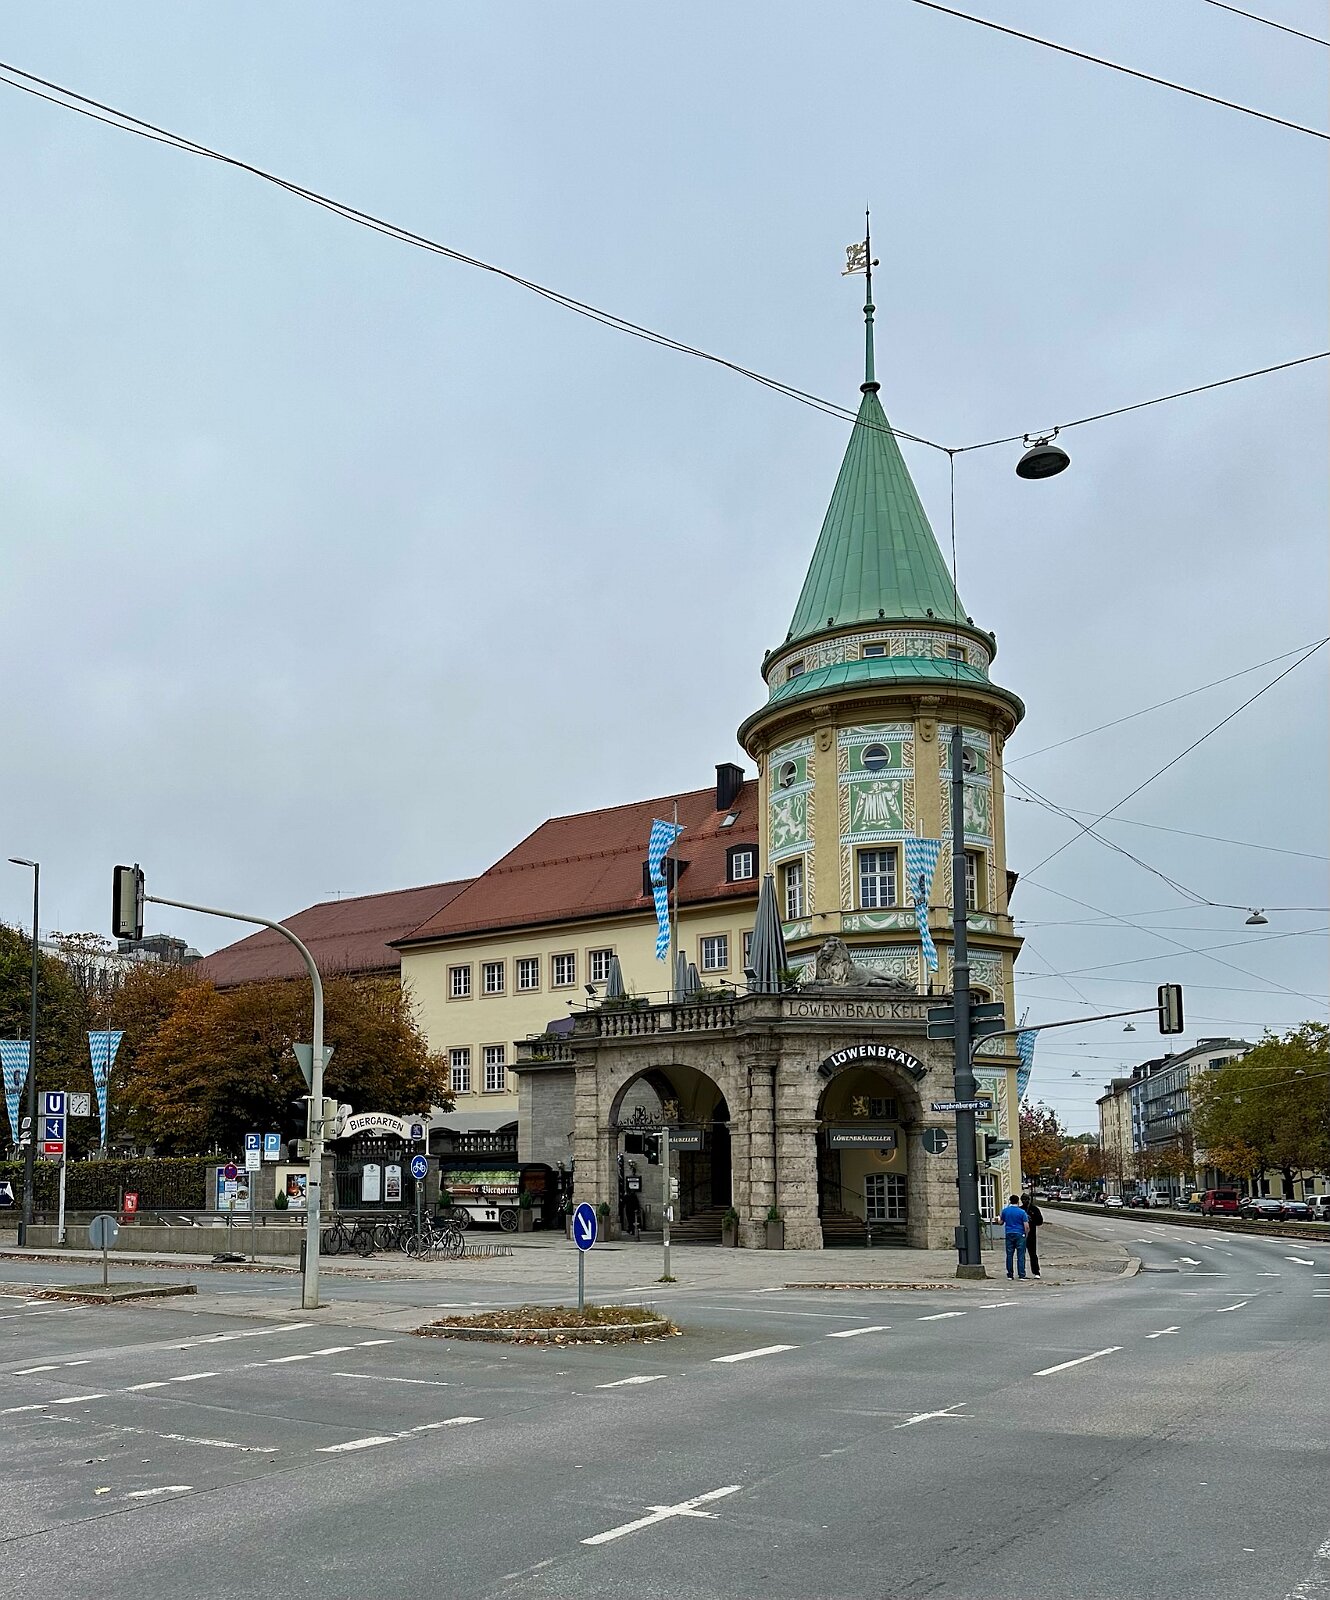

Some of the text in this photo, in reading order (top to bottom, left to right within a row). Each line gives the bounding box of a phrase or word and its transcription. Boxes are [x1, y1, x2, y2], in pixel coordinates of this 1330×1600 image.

[890, 1003, 926, 1018] KELL
[831, 1045, 918, 1068] LÖWENBRÄU
[49, 1095, 61, 1112] U
[933, 1101, 990, 1111] Nymphenburger Str.
[350, 1116, 404, 1132] BIERGARTEN
[247, 1135, 256, 1149] P
[268, 1136, 277, 1149] P
[832, 1134, 892, 1142] LÖWENBRÄUKELLER
[481, 1185, 518, 1195] Biergarten
